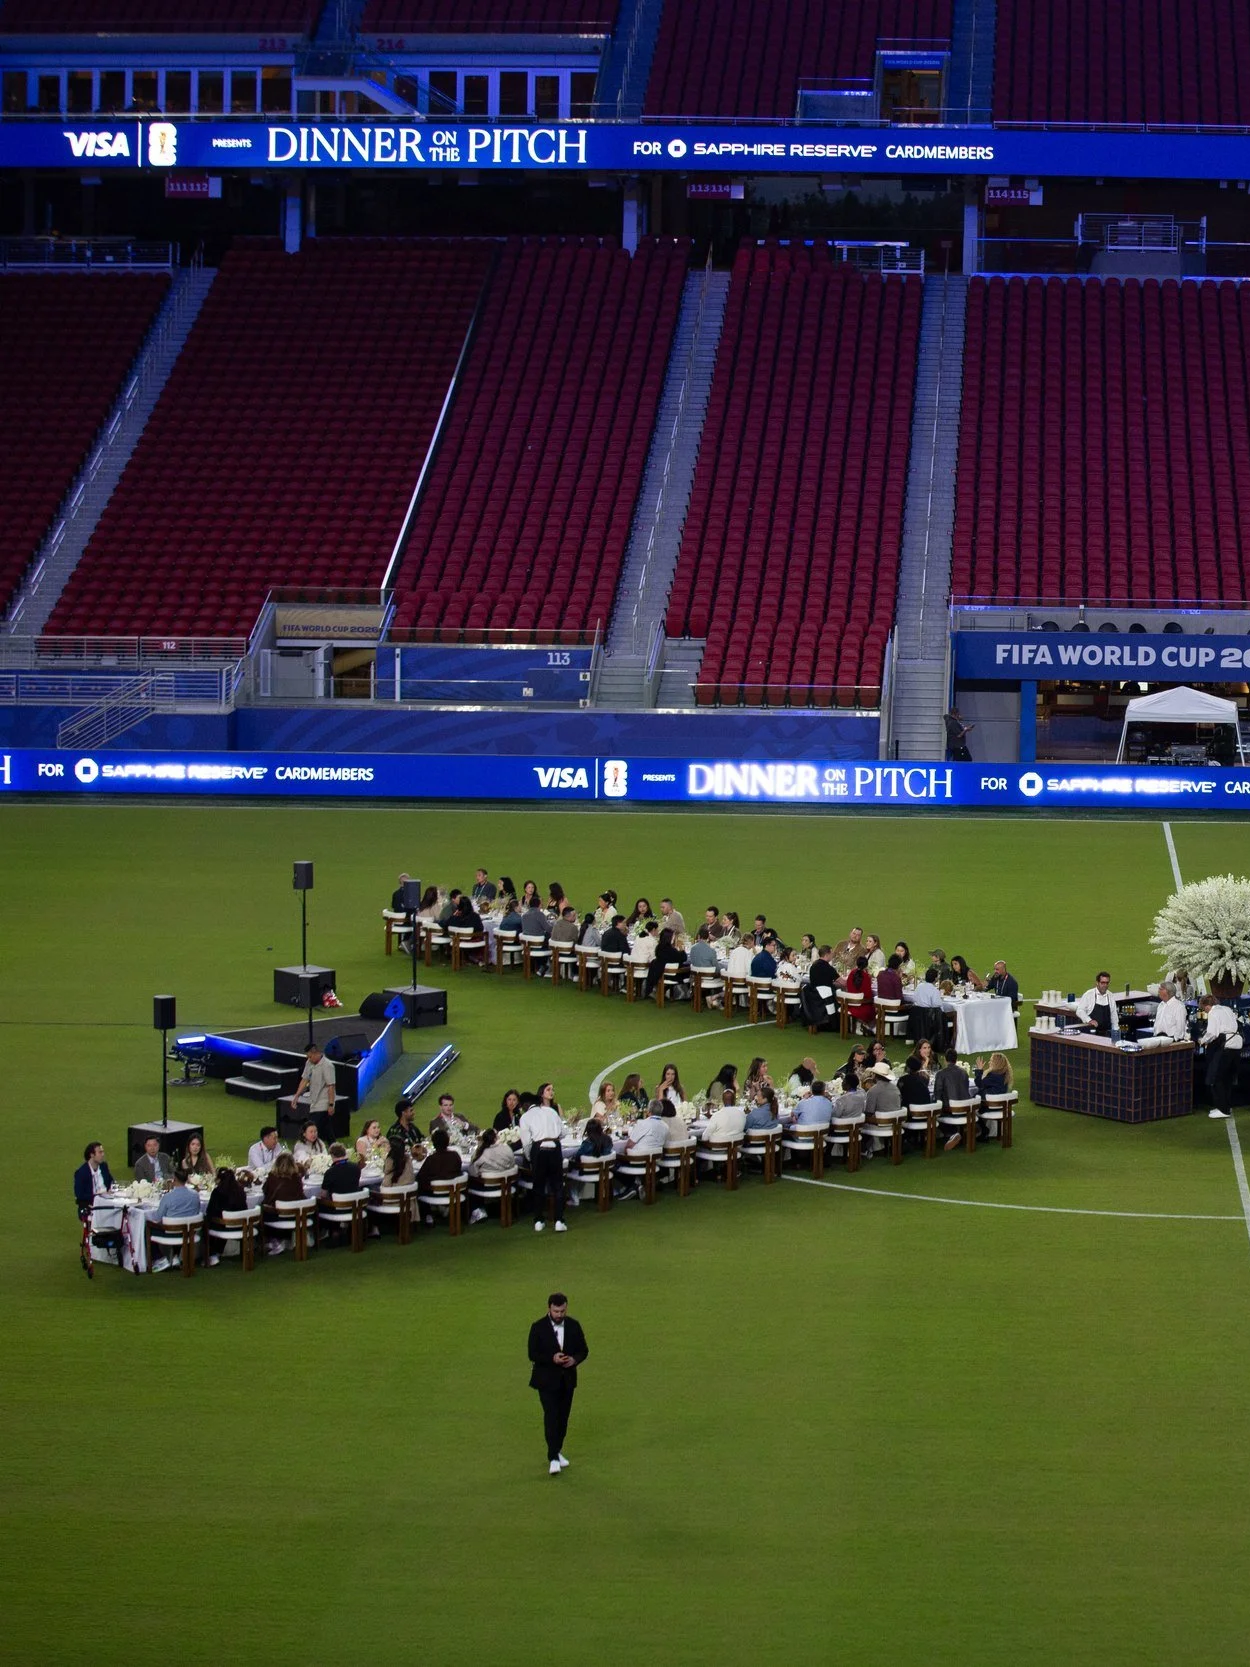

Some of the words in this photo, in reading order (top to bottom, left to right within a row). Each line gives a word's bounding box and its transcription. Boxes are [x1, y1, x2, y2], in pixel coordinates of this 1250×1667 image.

[63, 131, 130, 157] VISA
[212, 138, 252, 149] PRESENTS
[267, 127, 425, 162] DINNER
[432, 130, 457, 146] ON
[467, 128, 587, 164] PITCH
[633, 141, 662, 155] FOR
[694, 142, 786, 156] SAPPHIRE
[885, 144, 994, 160] CARDMEMBERS
[429, 146, 460, 162] THE
[988, 190, 1008, 199] 114
[1010, 190, 1029, 199] 115
[283, 624, 300, 632] FIFA
[302, 625, 331, 633] WORLD
[332, 625, 349, 633] CUP
[350, 626, 379, 634] 2026
[162, 641, 176, 650] 112
[547, 652, 571, 666] 113
[995, 644, 1053, 665] FIFA
[1057, 645, 1156, 667] WORLD
[1161, 647, 1216, 668] CUP
[38, 763, 64, 777] FOR
[102, 764, 185, 779] SAPPHIRE
[275, 766, 374, 781] CARDMEMBERS
[533, 767, 589, 789] VISA
[642, 774, 676, 782] PRESENTS
[824, 769, 846, 782] ON
[688, 763, 820, 797] DINNER
[854, 767, 953, 798] PITCH
[981, 777, 1008, 790] FOR
[1047, 778, 1132, 792] SAPPHIRE
[822, 783, 849, 796] THE
